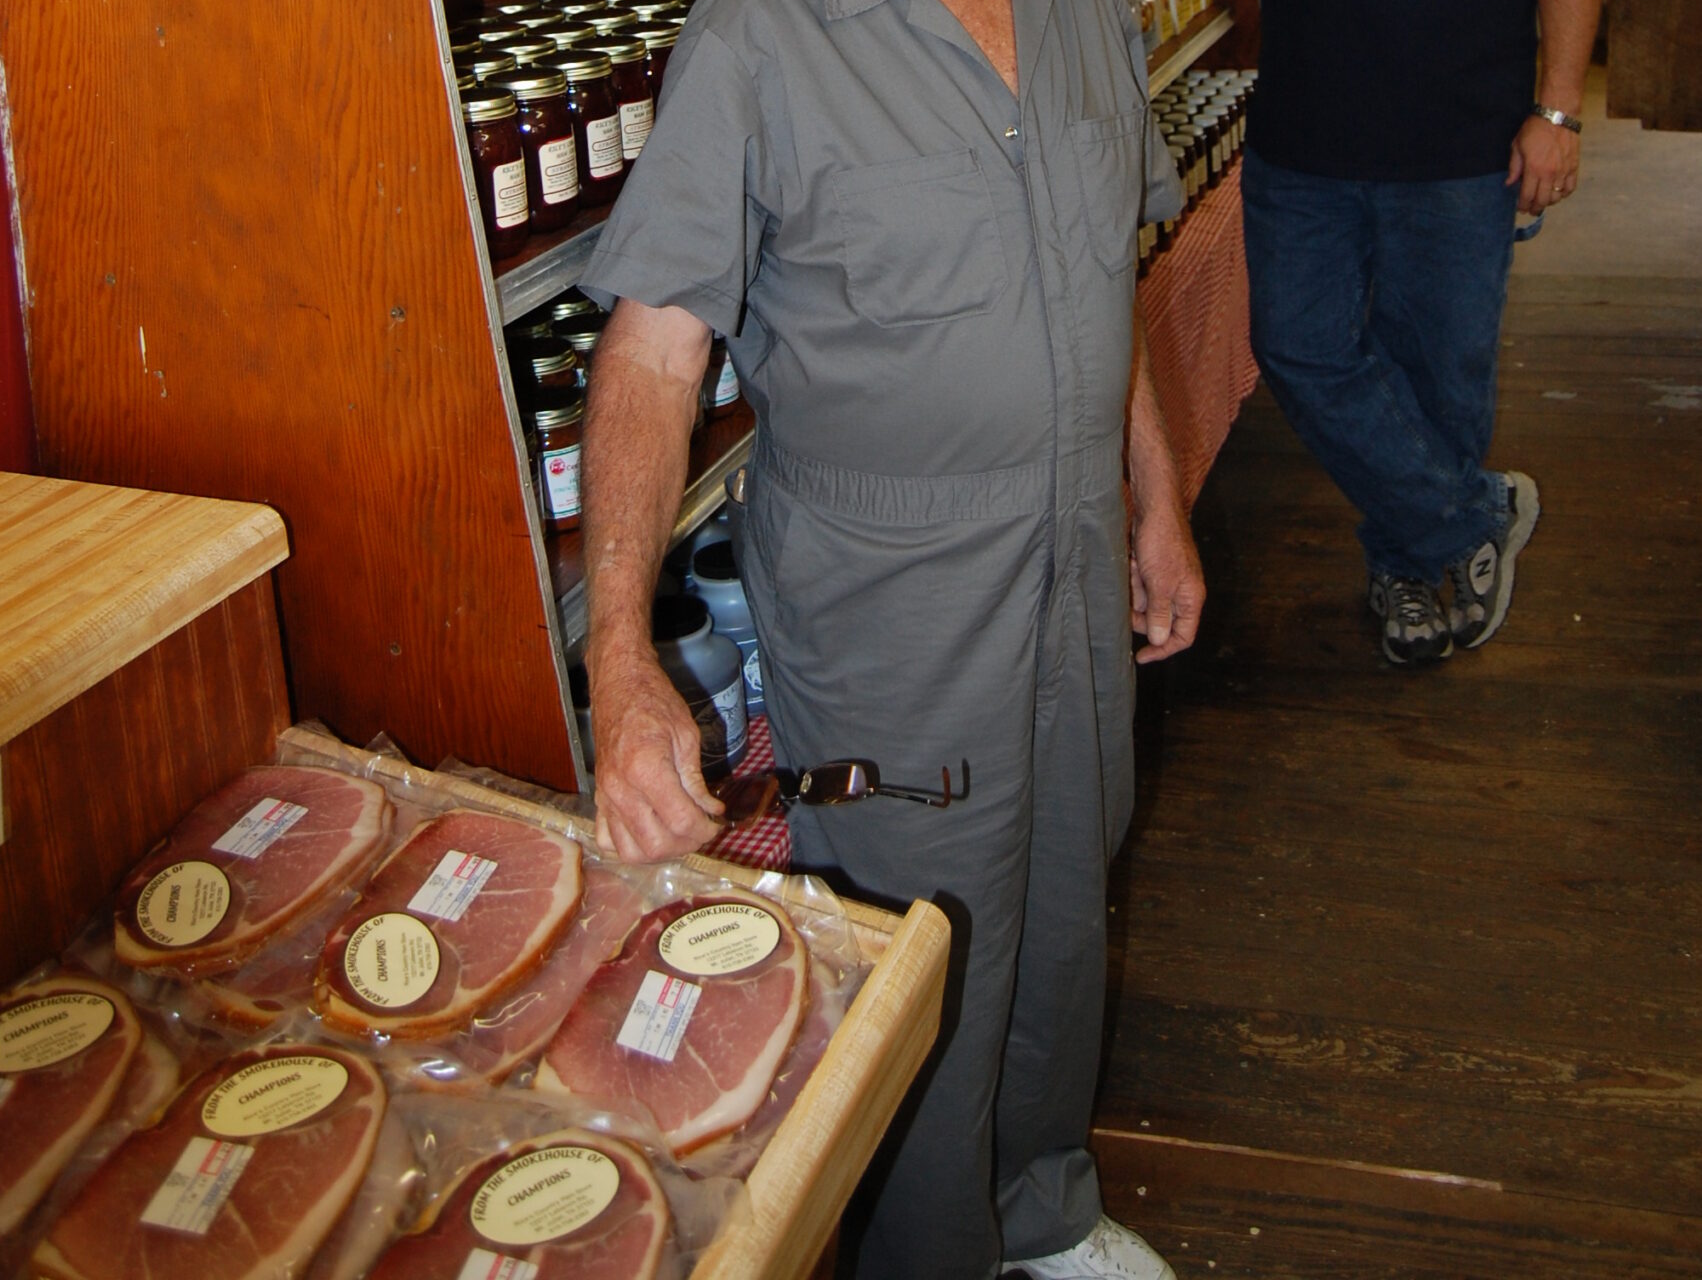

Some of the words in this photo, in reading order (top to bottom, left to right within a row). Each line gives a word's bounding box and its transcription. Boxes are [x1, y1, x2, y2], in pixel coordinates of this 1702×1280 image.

[347, 923, 373, 973] SMOKEHOUSE
[372, 916, 385, 927] OF
[661, 931, 675, 954] FROM
[671, 919, 687, 933] THE
[686, 906, 752, 923] SMOKEHOUSE
[753, 911, 769, 920] OF
[688, 921, 741, 946] CHAMPIONS
[376, 938, 389, 982] CHAMPIONS
[3, 1010, 69, 1043] CHAMPIONS
[7, 996, 86, 1020] SMOKEHOUSE
[204, 1094, 222, 1120] FROM
[220, 1077, 239, 1094] THE
[238, 1058, 314, 1081] SMOKEHOUSE
[238, 1071, 302, 1105] CHAMPIONS
[473, 1193, 491, 1222] FROM
[486, 1173, 506, 1192] THE
[505, 1149, 583, 1176] SMOKEHOUSE
[587, 1153, 606, 1164] OF
[507, 1168, 571, 1207] CHAMPIONS
